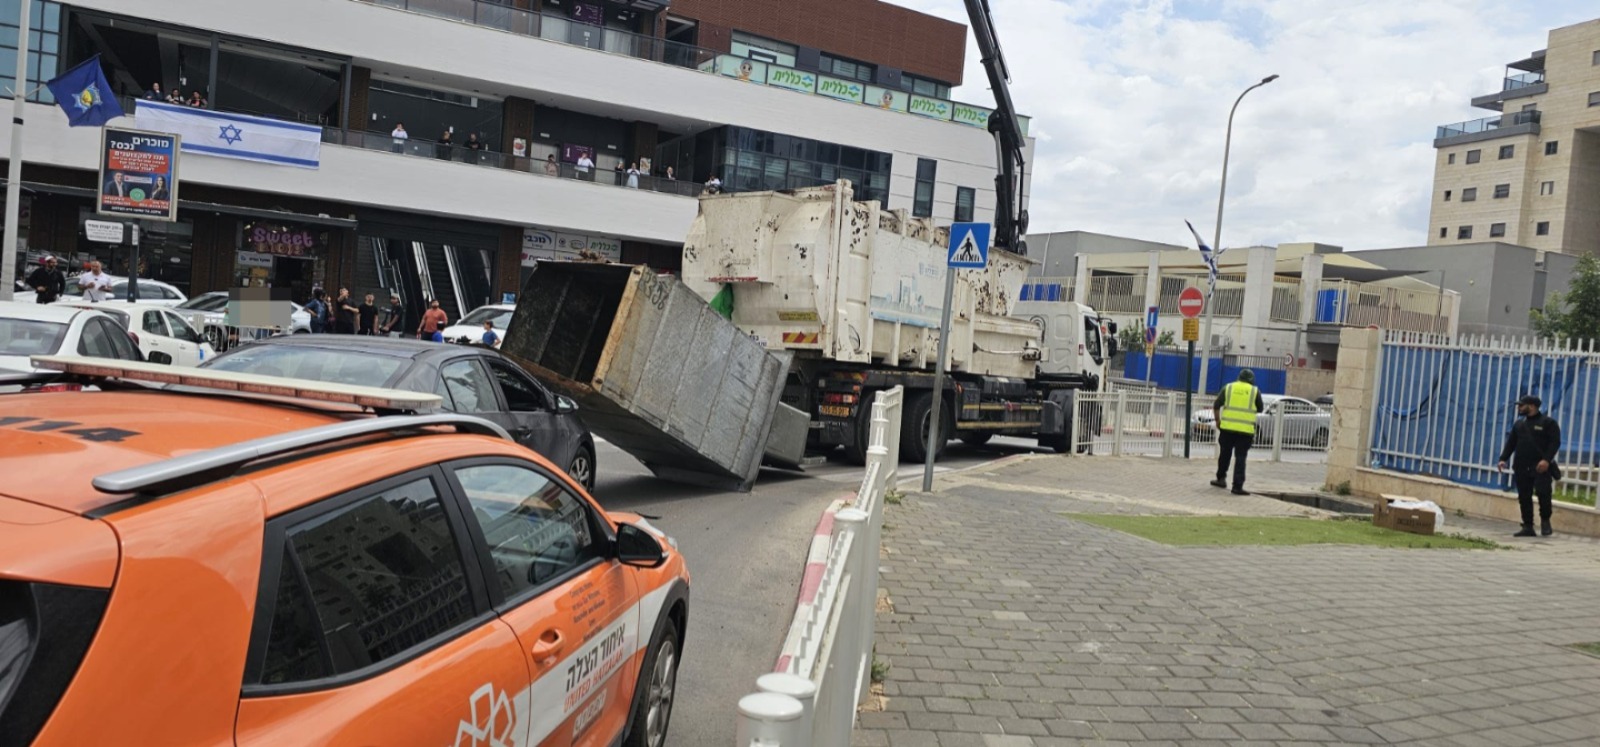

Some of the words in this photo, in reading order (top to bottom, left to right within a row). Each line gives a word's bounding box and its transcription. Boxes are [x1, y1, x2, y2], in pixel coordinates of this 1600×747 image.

[575, 5, 582, 16] 2
[773, 70, 802, 85] כללית
[821, 80, 849, 96] כללית
[911, 98, 936, 113] כללית
[954, 107, 977, 121] כללית
[110, 140, 134, 150] נכס?
[132, 136, 170, 148] מוכרים
[566, 147, 570, 157] 1
[253, 227, 313, 248] Sweet
[590, 241, 610, 251] כללית
[601, 622, 625, 660] איחוד
[566, 645, 598, 693] הצלה
[563, 678, 591, 713] UNITED
